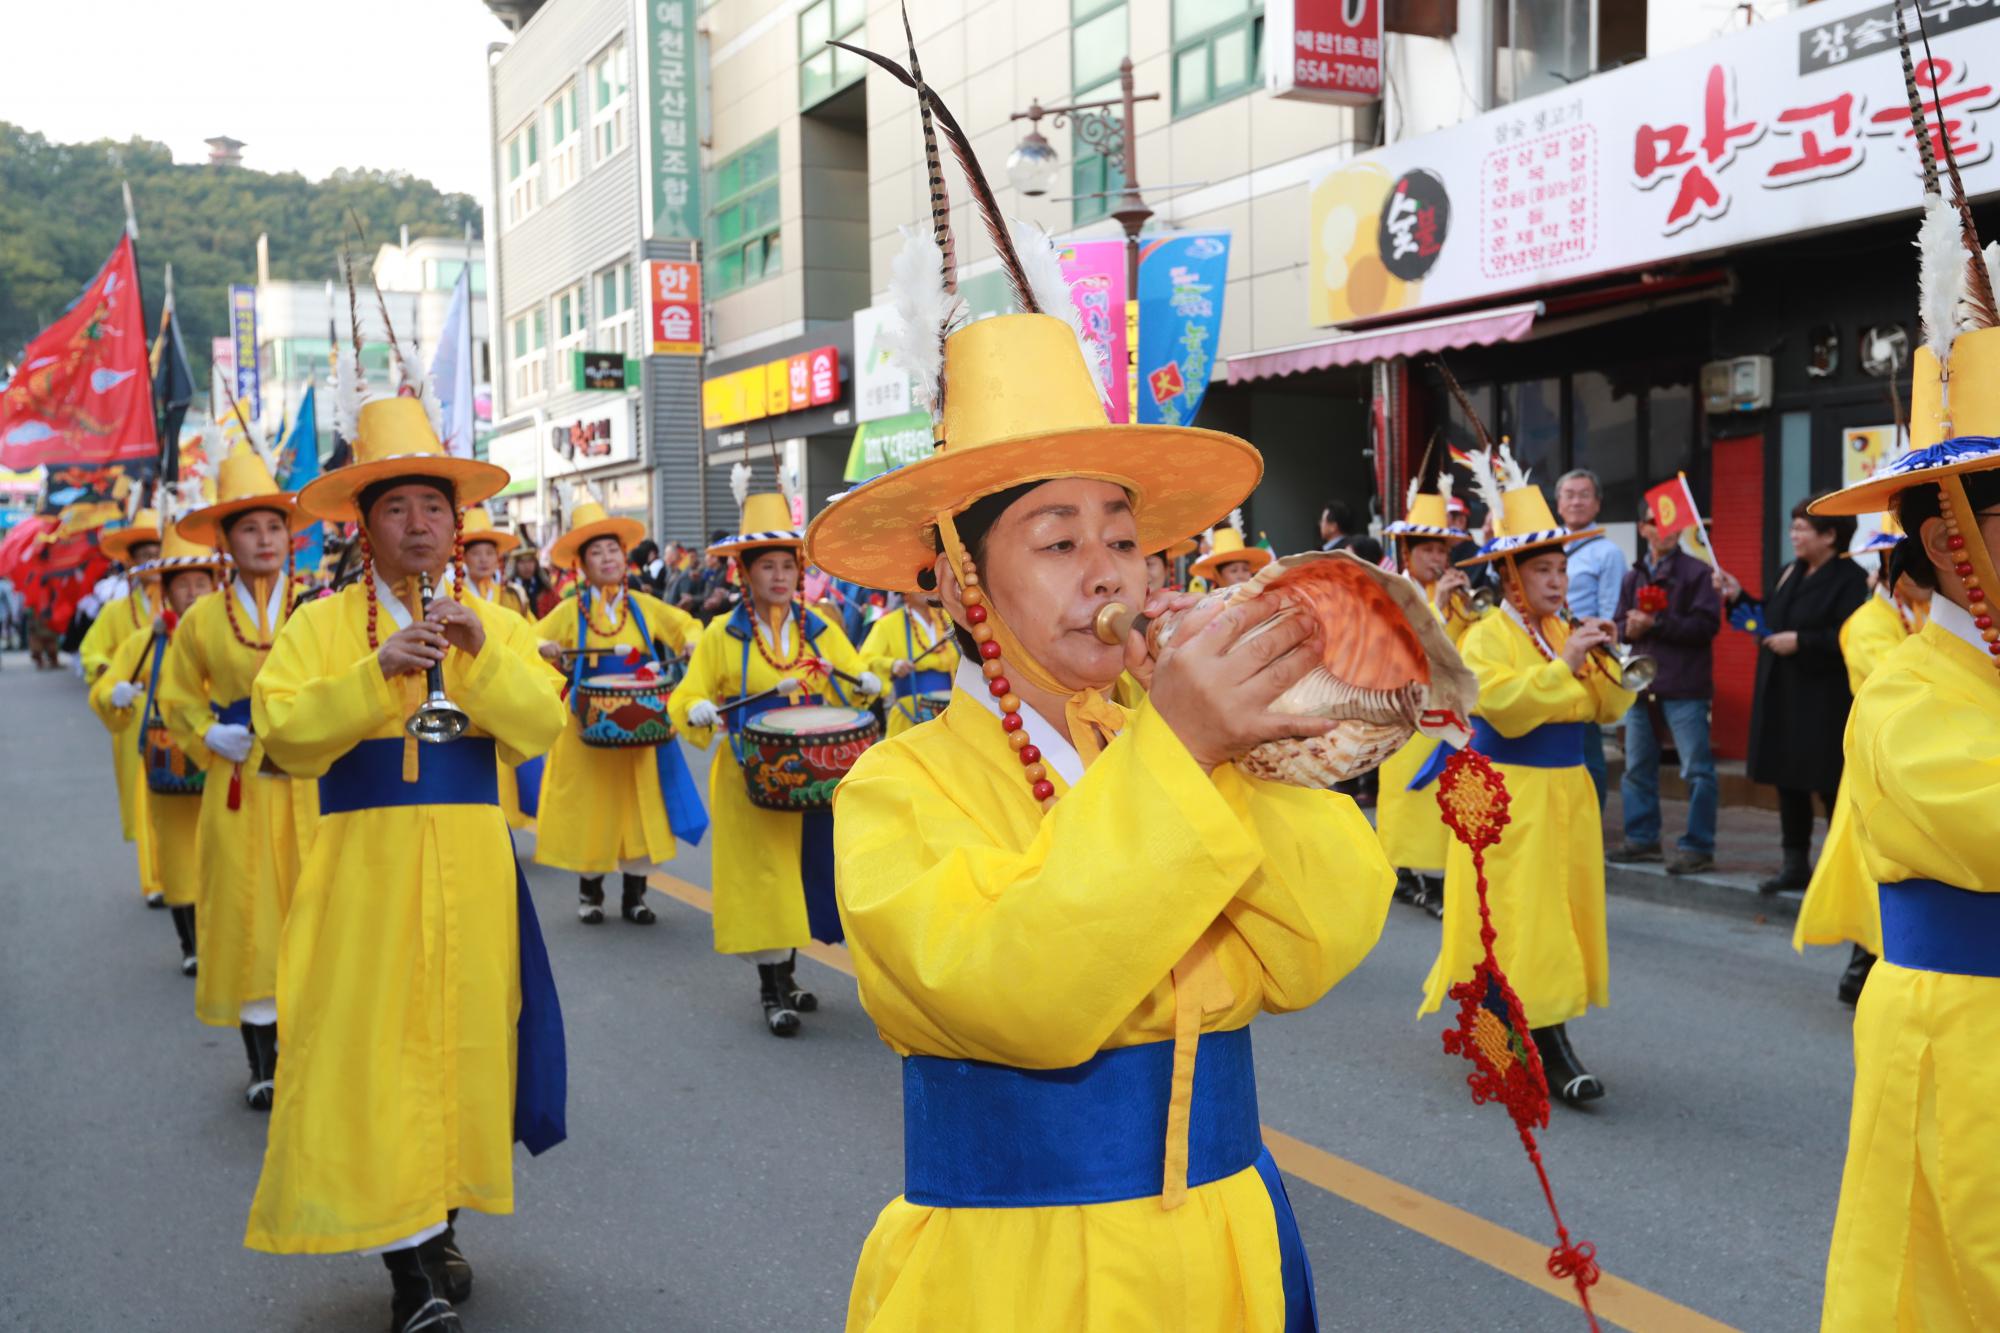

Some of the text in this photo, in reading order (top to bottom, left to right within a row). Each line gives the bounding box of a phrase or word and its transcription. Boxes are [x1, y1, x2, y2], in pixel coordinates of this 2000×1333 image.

[656, 2, 689, 206] 예천군산림조합
[1295, 58, 1378, 89] 654-7900
[1634, 63, 1992, 225] 맛고을
[657, 264, 693, 341] 한솥
[789, 354, 834, 404] 한솥
